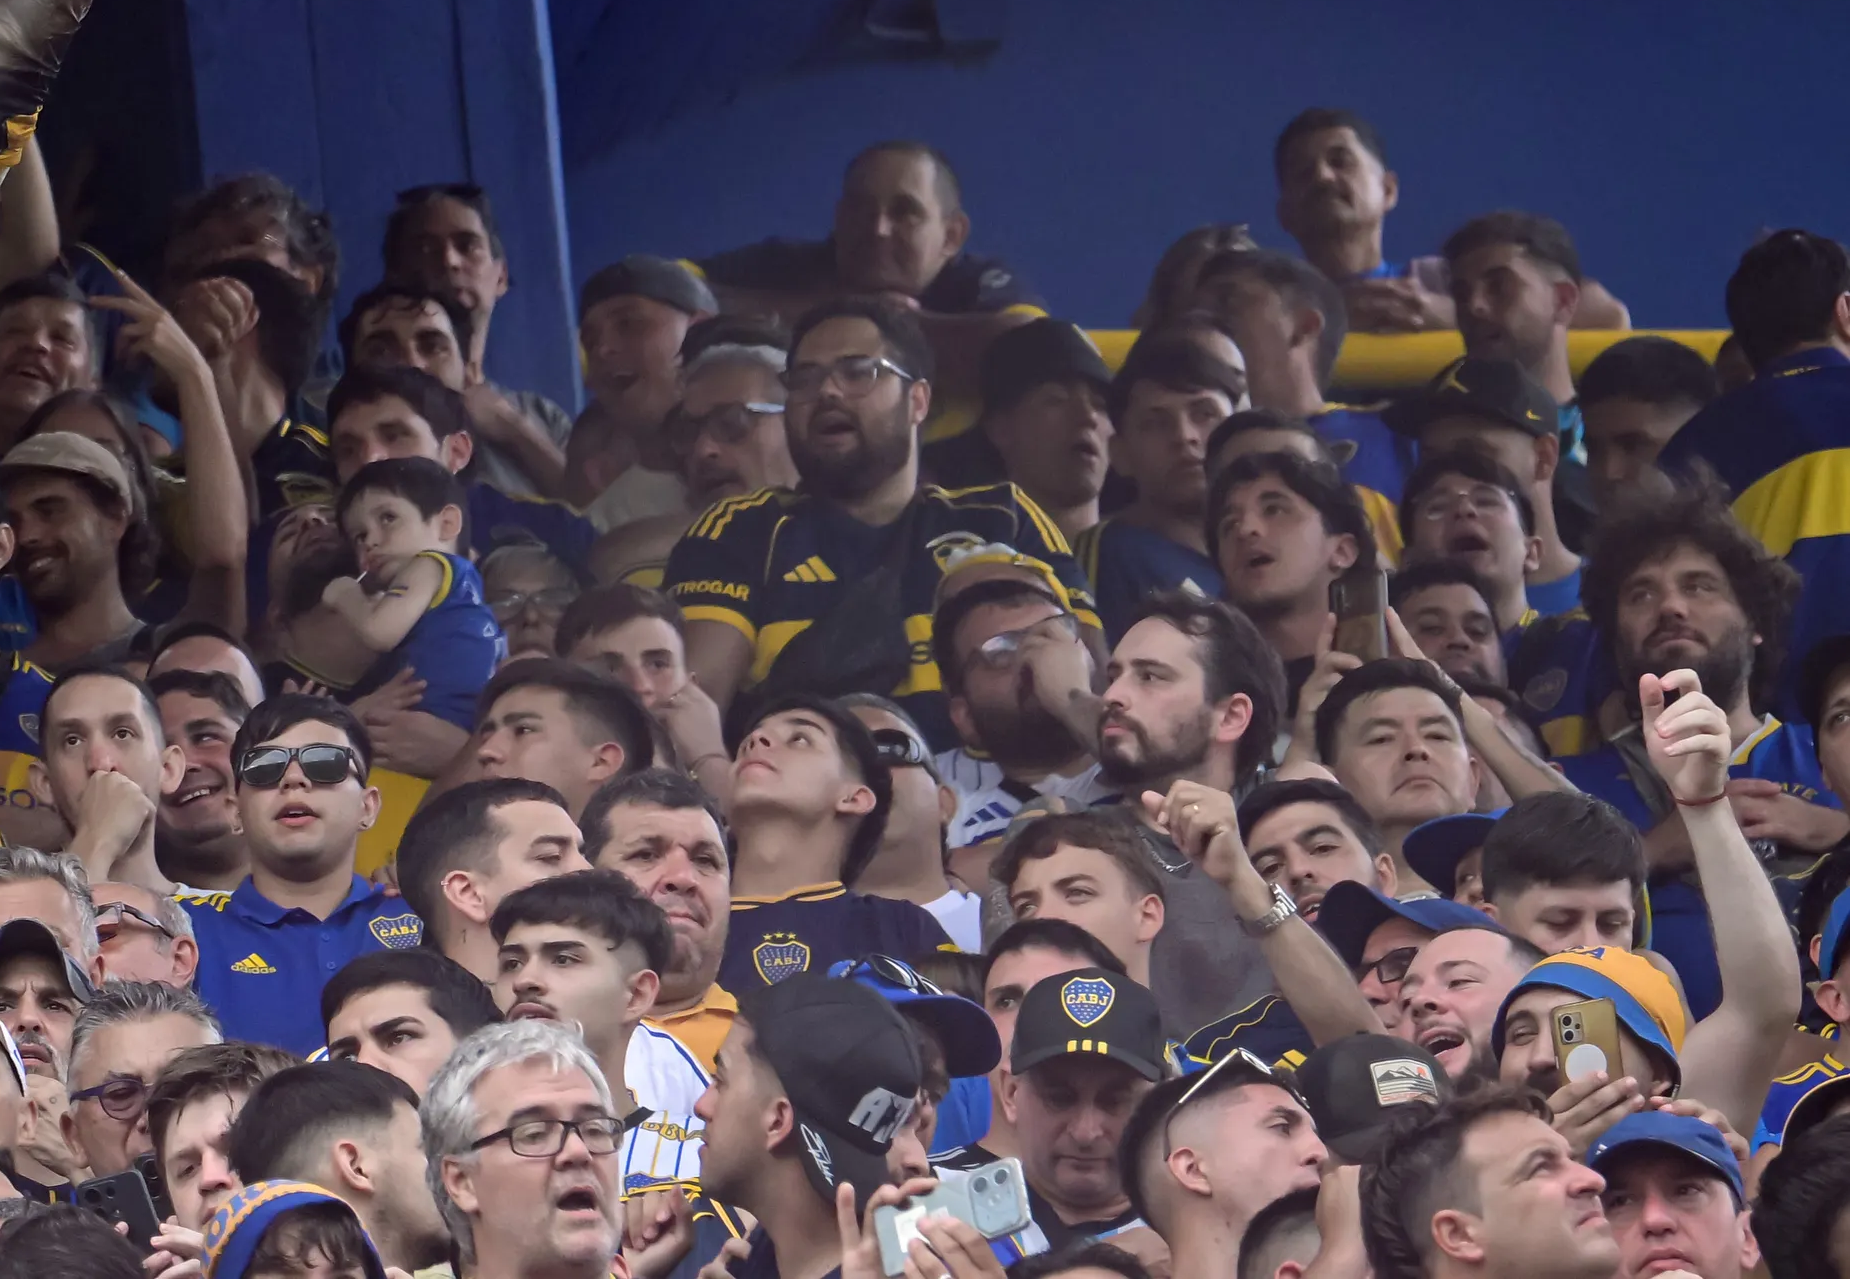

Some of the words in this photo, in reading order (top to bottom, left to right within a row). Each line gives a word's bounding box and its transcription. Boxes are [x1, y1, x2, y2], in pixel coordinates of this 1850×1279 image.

[379, 924, 419, 938] CABJ
[763, 955, 802, 968] CABJ
[1065, 992, 1110, 1007] CABJ
